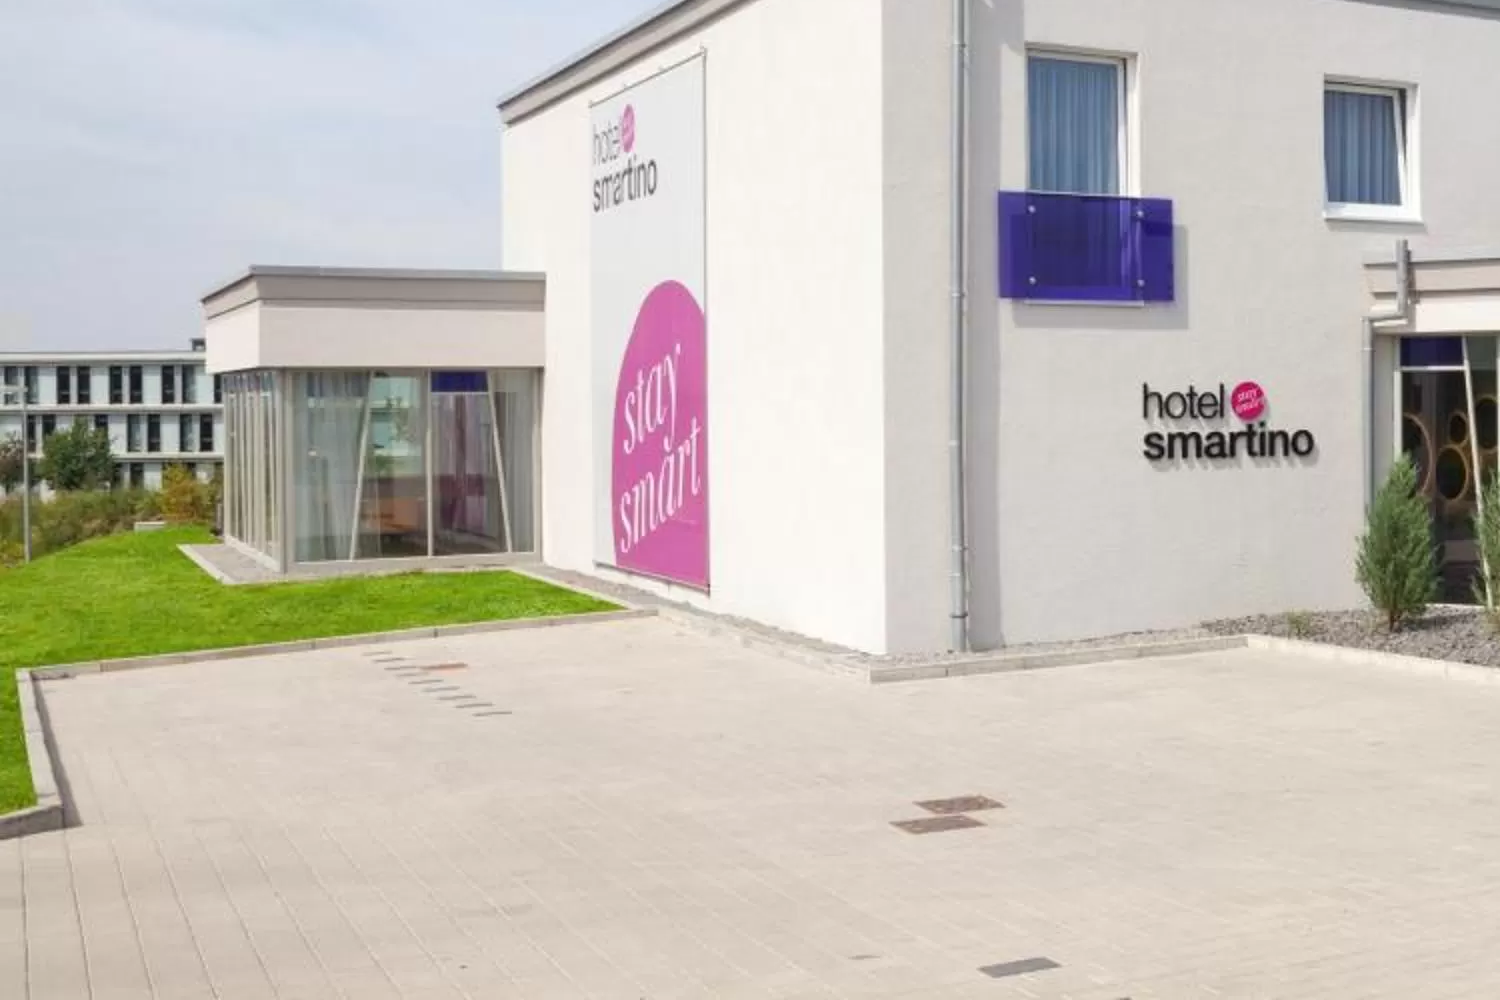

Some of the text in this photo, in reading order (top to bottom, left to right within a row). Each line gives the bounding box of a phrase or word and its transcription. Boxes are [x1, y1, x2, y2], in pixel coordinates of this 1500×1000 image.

[593, 153, 657, 212] smartino
[624, 343, 681, 454] stay
[1143, 382, 1224, 419] hotel
[1143, 421, 1314, 460] smartino
[620, 417, 701, 553] smart
